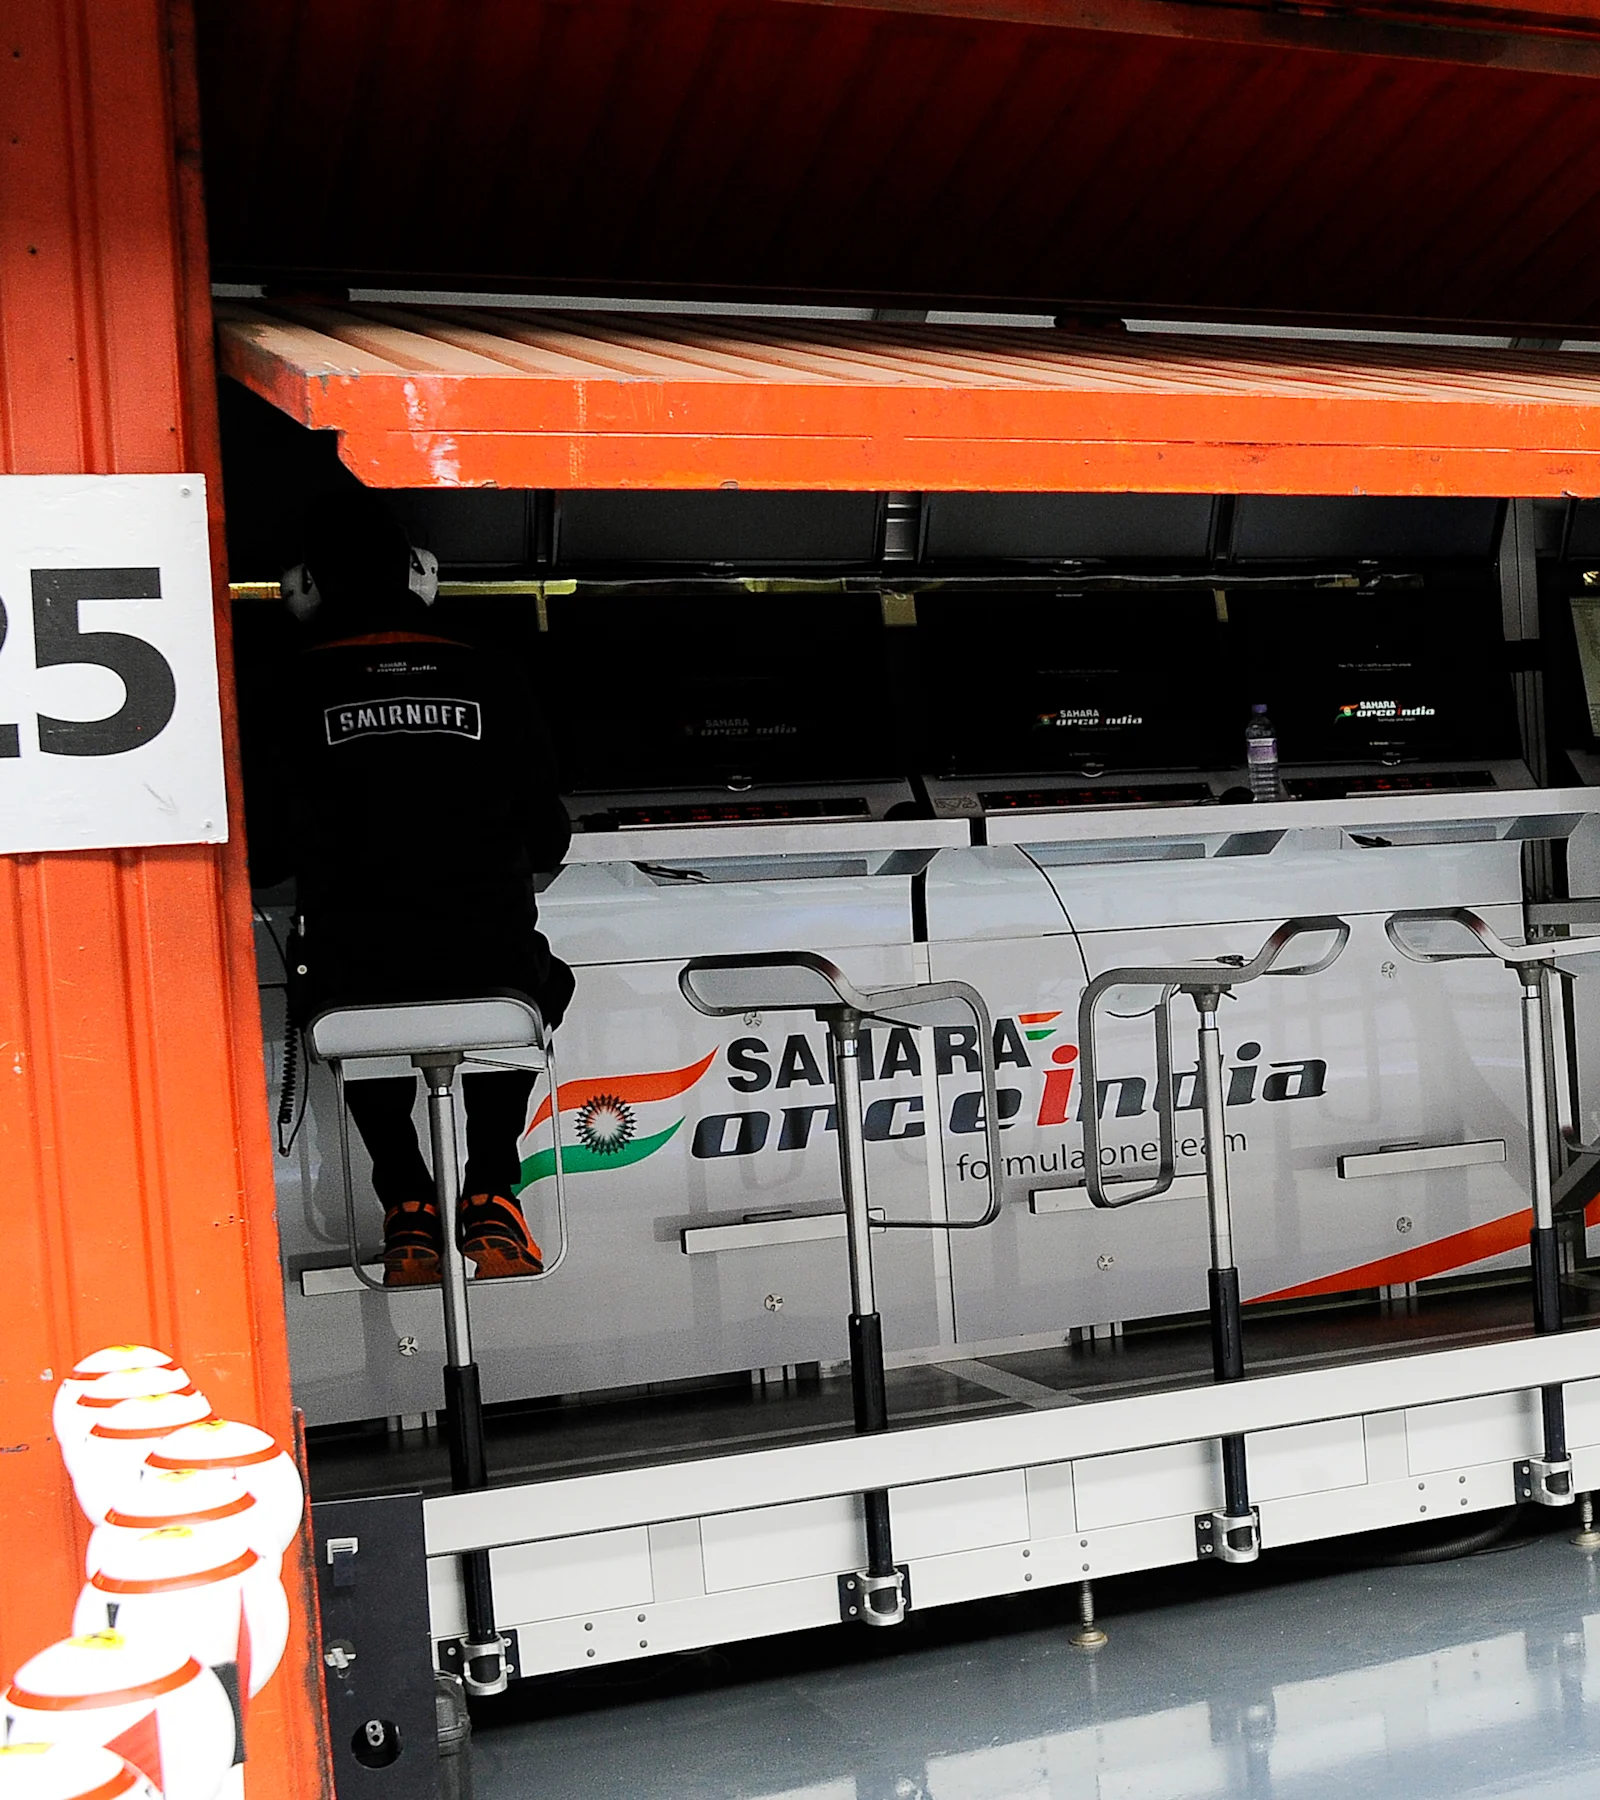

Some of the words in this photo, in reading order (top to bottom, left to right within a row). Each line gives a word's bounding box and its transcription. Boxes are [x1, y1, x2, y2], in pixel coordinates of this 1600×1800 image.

[0, 567, 176, 757] 5
[1060, 709, 1100, 718] SAHARA
[1360, 700, 1396, 709] SAHARA
[727, 1018, 1031, 1094] SAHARA
[957, 1144, 1085, 1181] fomula
[1100, 1142, 1158, 1166] one
